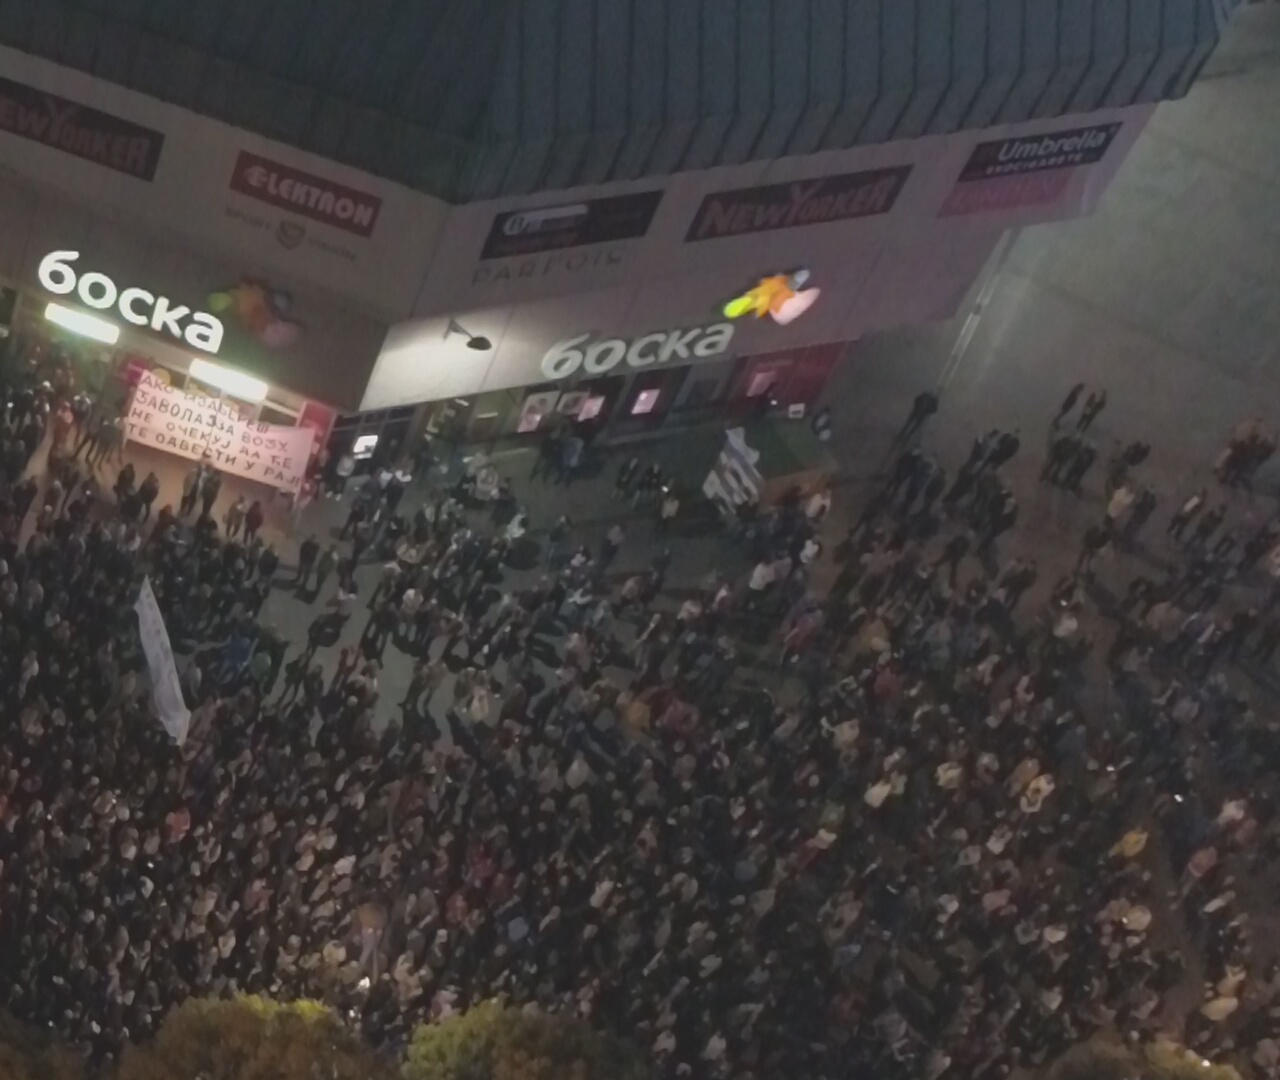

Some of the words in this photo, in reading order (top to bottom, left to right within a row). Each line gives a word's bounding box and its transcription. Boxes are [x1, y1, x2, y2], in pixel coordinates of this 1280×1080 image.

[998, 129, 1107, 161] Umbrella
[244, 165, 373, 226] ELEKTRON
[38, 250, 224, 354] боска
[541, 322, 735, 380] боска
[132, 407, 154, 423] НЕ
[129, 423, 147, 439] ТЕ
[155, 431, 237, 467] ОДВЕСТИ
